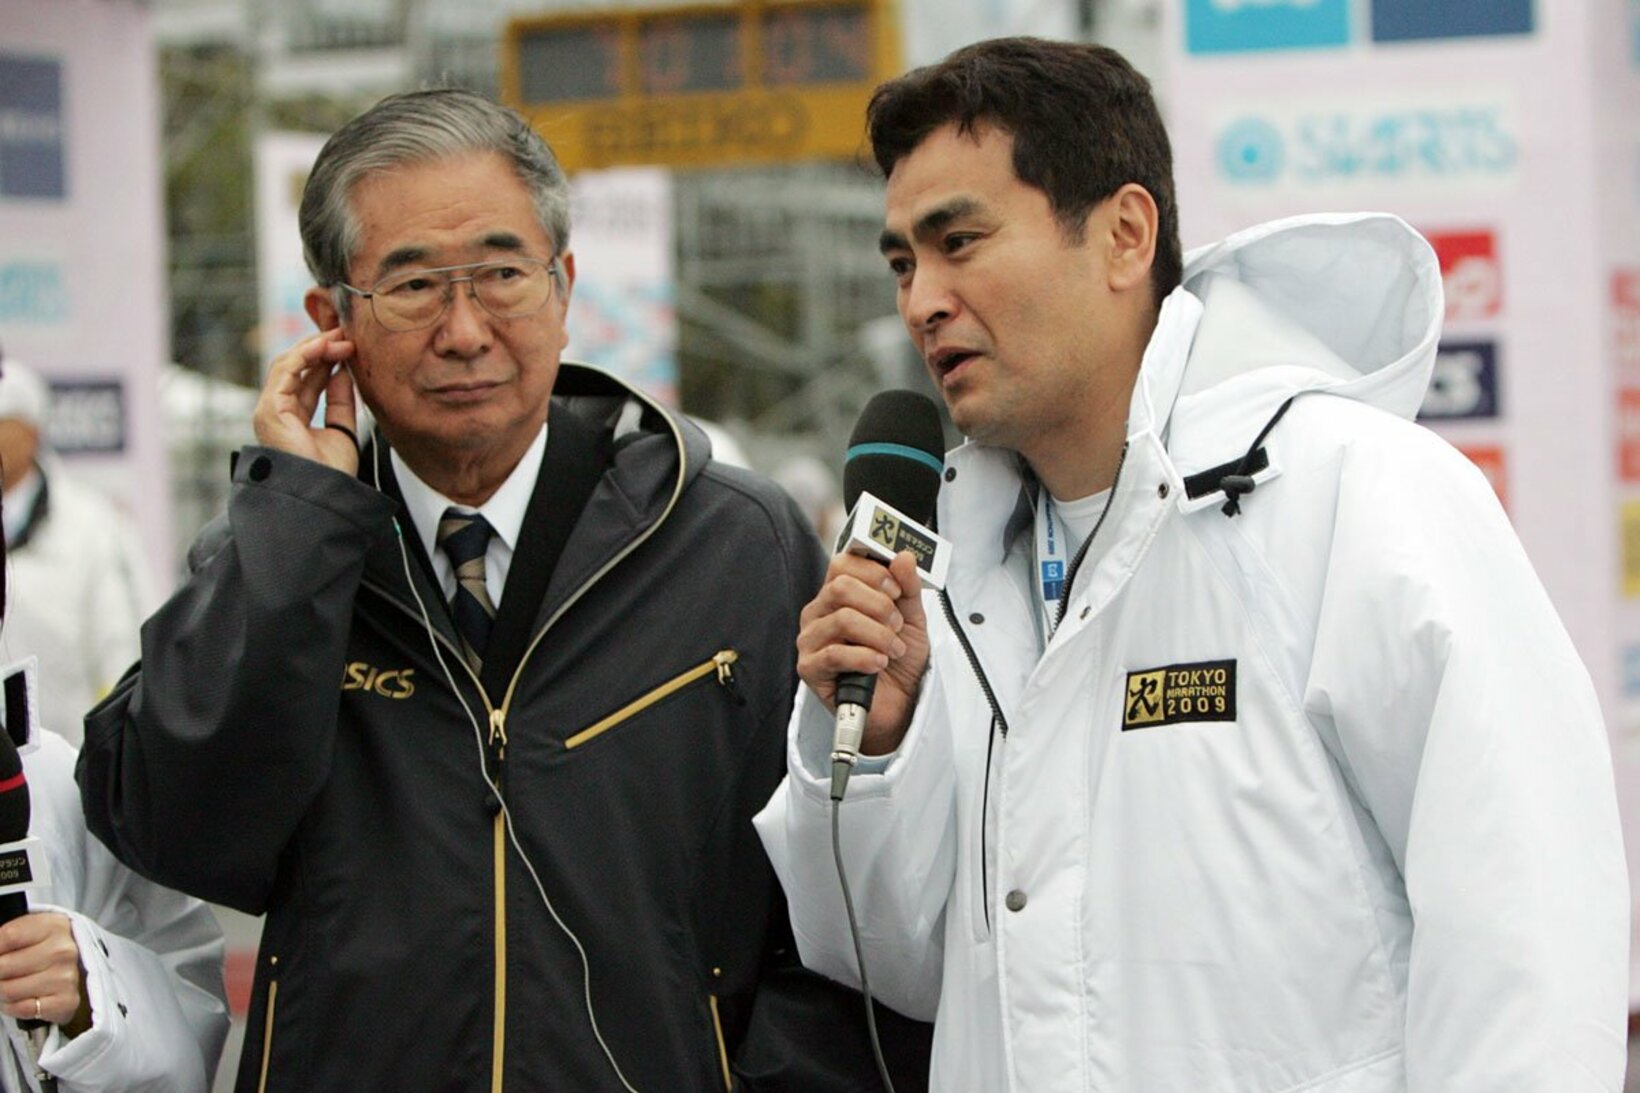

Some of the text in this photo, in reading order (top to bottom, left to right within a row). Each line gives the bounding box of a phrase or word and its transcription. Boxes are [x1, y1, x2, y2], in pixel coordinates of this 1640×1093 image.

[342, 661, 415, 699] SICS
[1168, 668, 1227, 687] TOKYO
[1166, 684, 1226, 699] MARATHON
[1167, 696, 1226, 715] 2009
